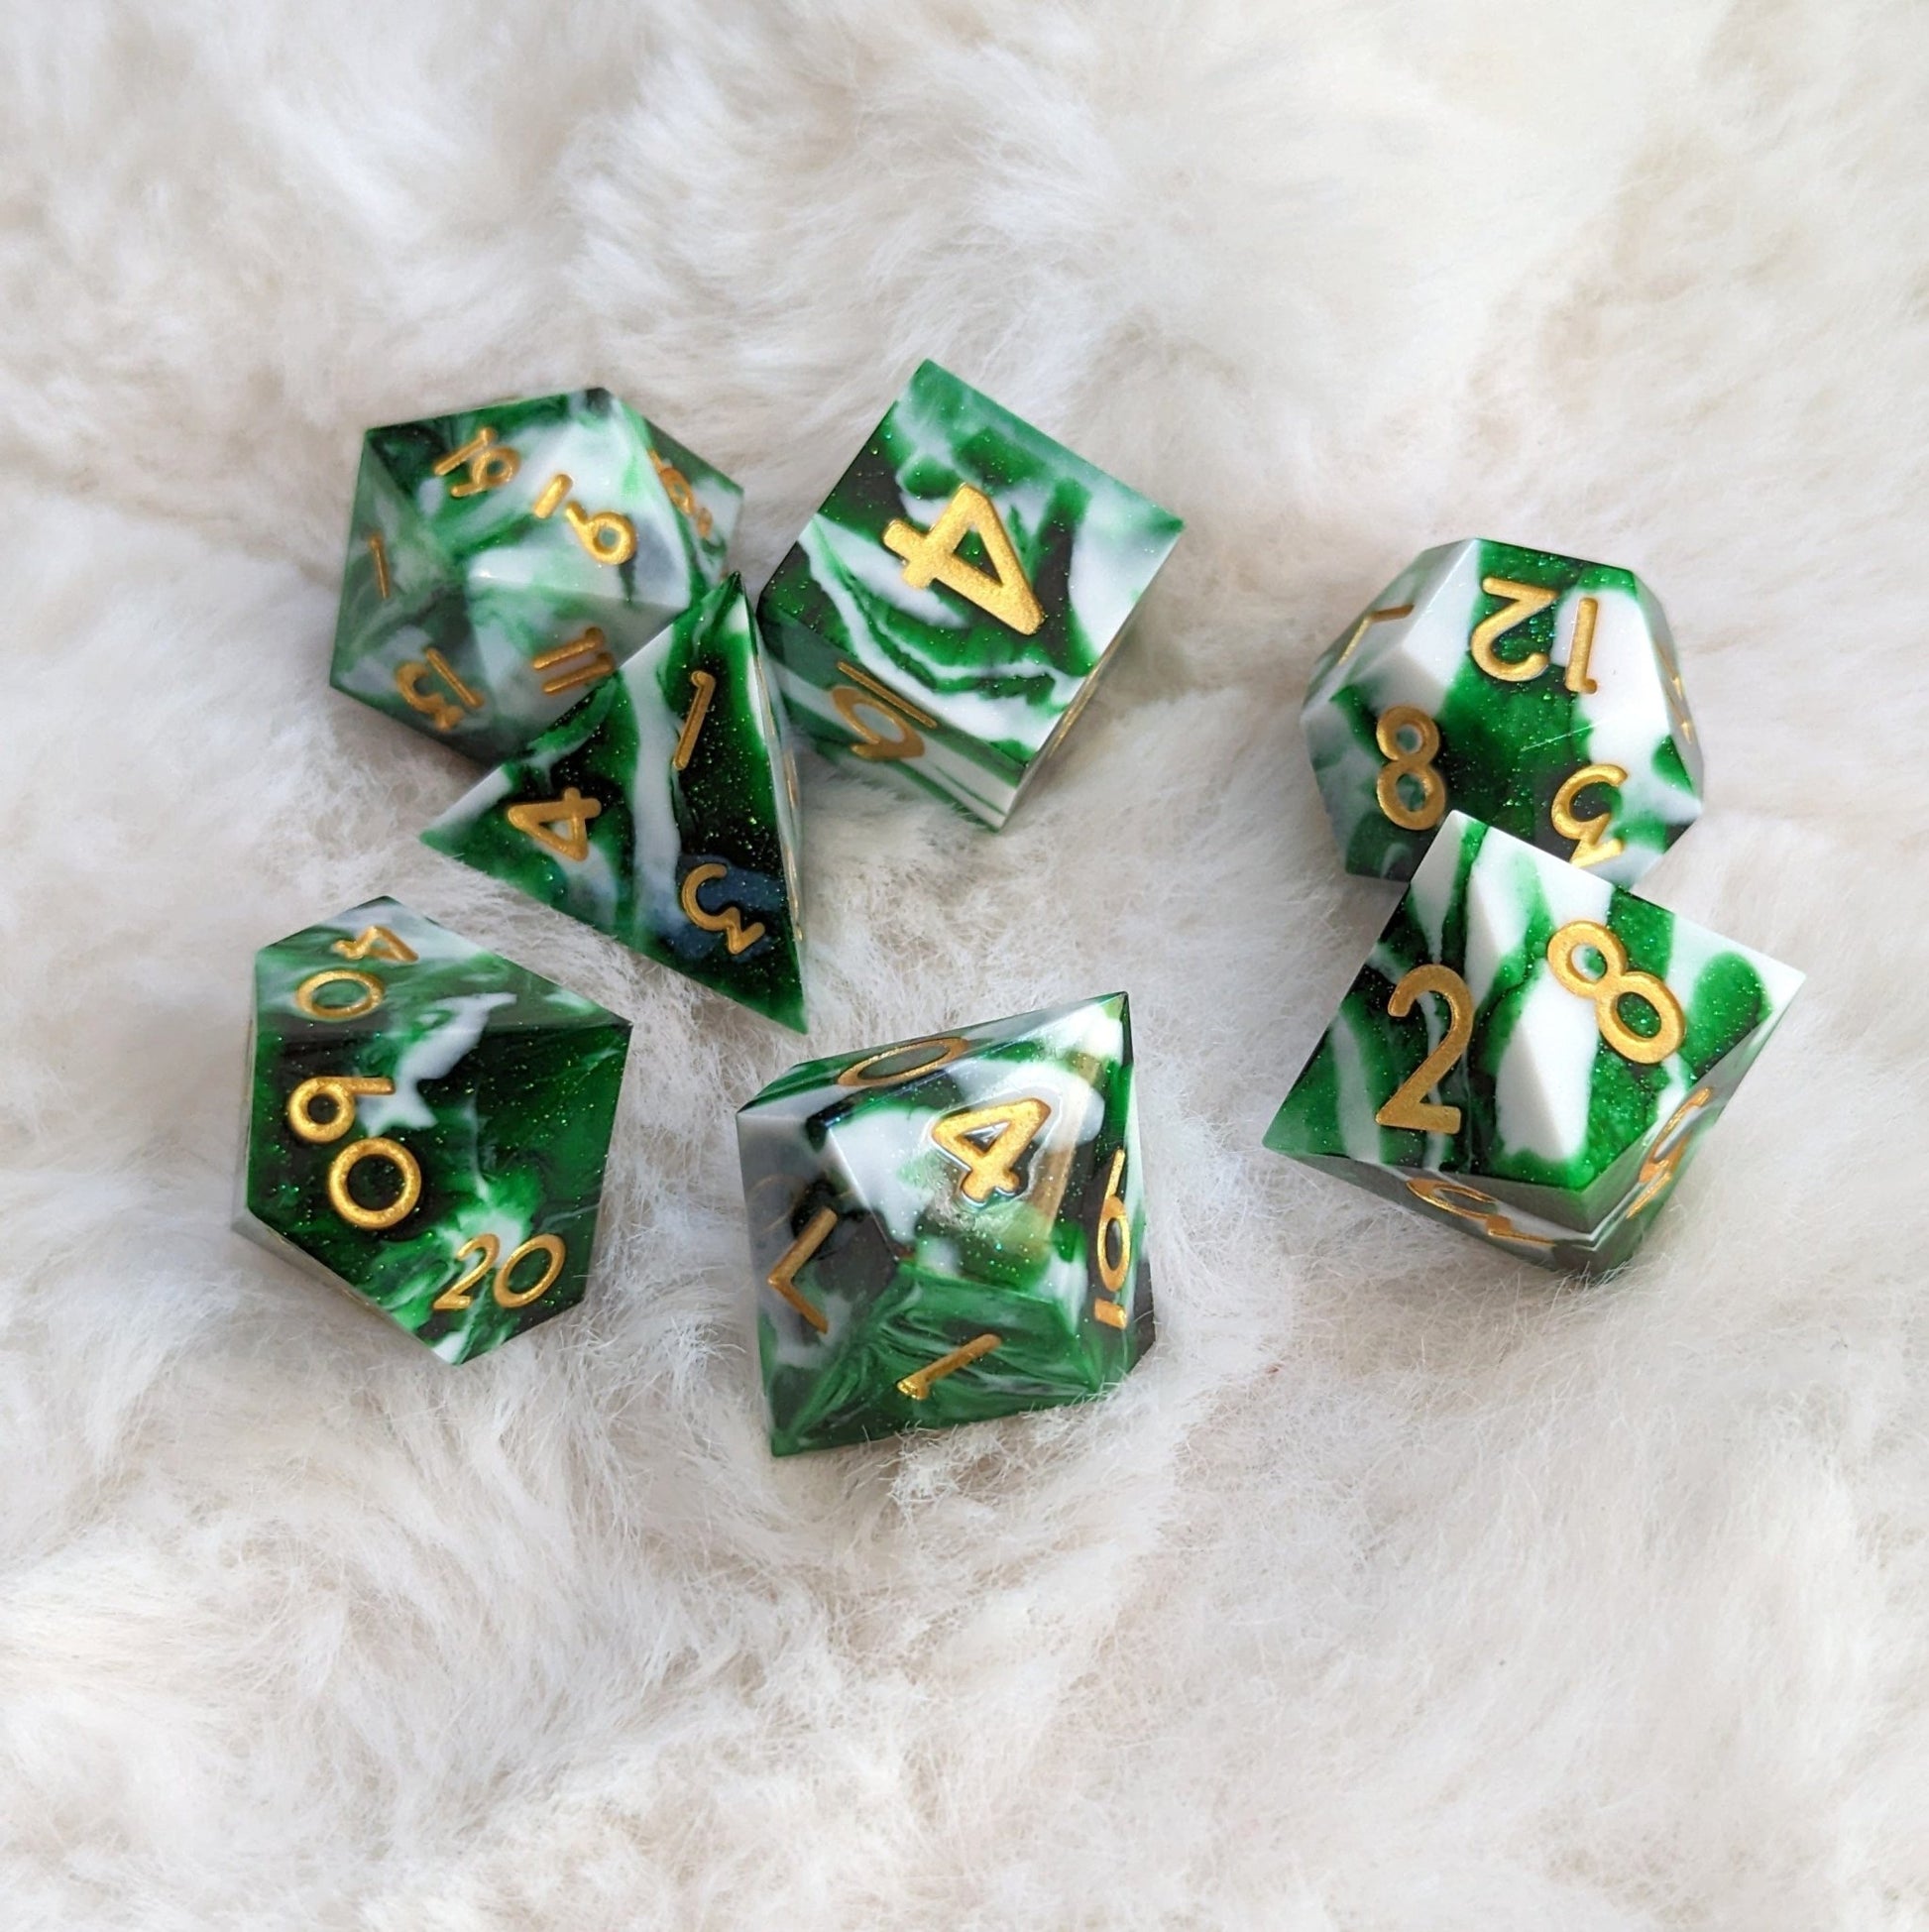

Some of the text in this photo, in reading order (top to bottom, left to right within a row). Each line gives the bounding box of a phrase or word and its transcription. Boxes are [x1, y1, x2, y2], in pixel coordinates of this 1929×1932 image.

[883, 485, 1044, 632] 4
[532, 626, 615, 696] 11
[1471, 577, 1599, 695] 12
[673, 671, 715, 770] 1
[1376, 705, 1446, 831] 8
[507, 787, 600, 860] 4
[681, 864, 764, 955] 3
[295, 925, 419, 1020] 40
[1548, 921, 1684, 1064] 8
[836, 1036, 969, 1086] 0
[1378, 964, 1474, 1134] 2
[934, 1099, 1055, 1201] 4
[432, 1234, 565, 1310] 20
[900, 1334, 1000, 1399] 1
